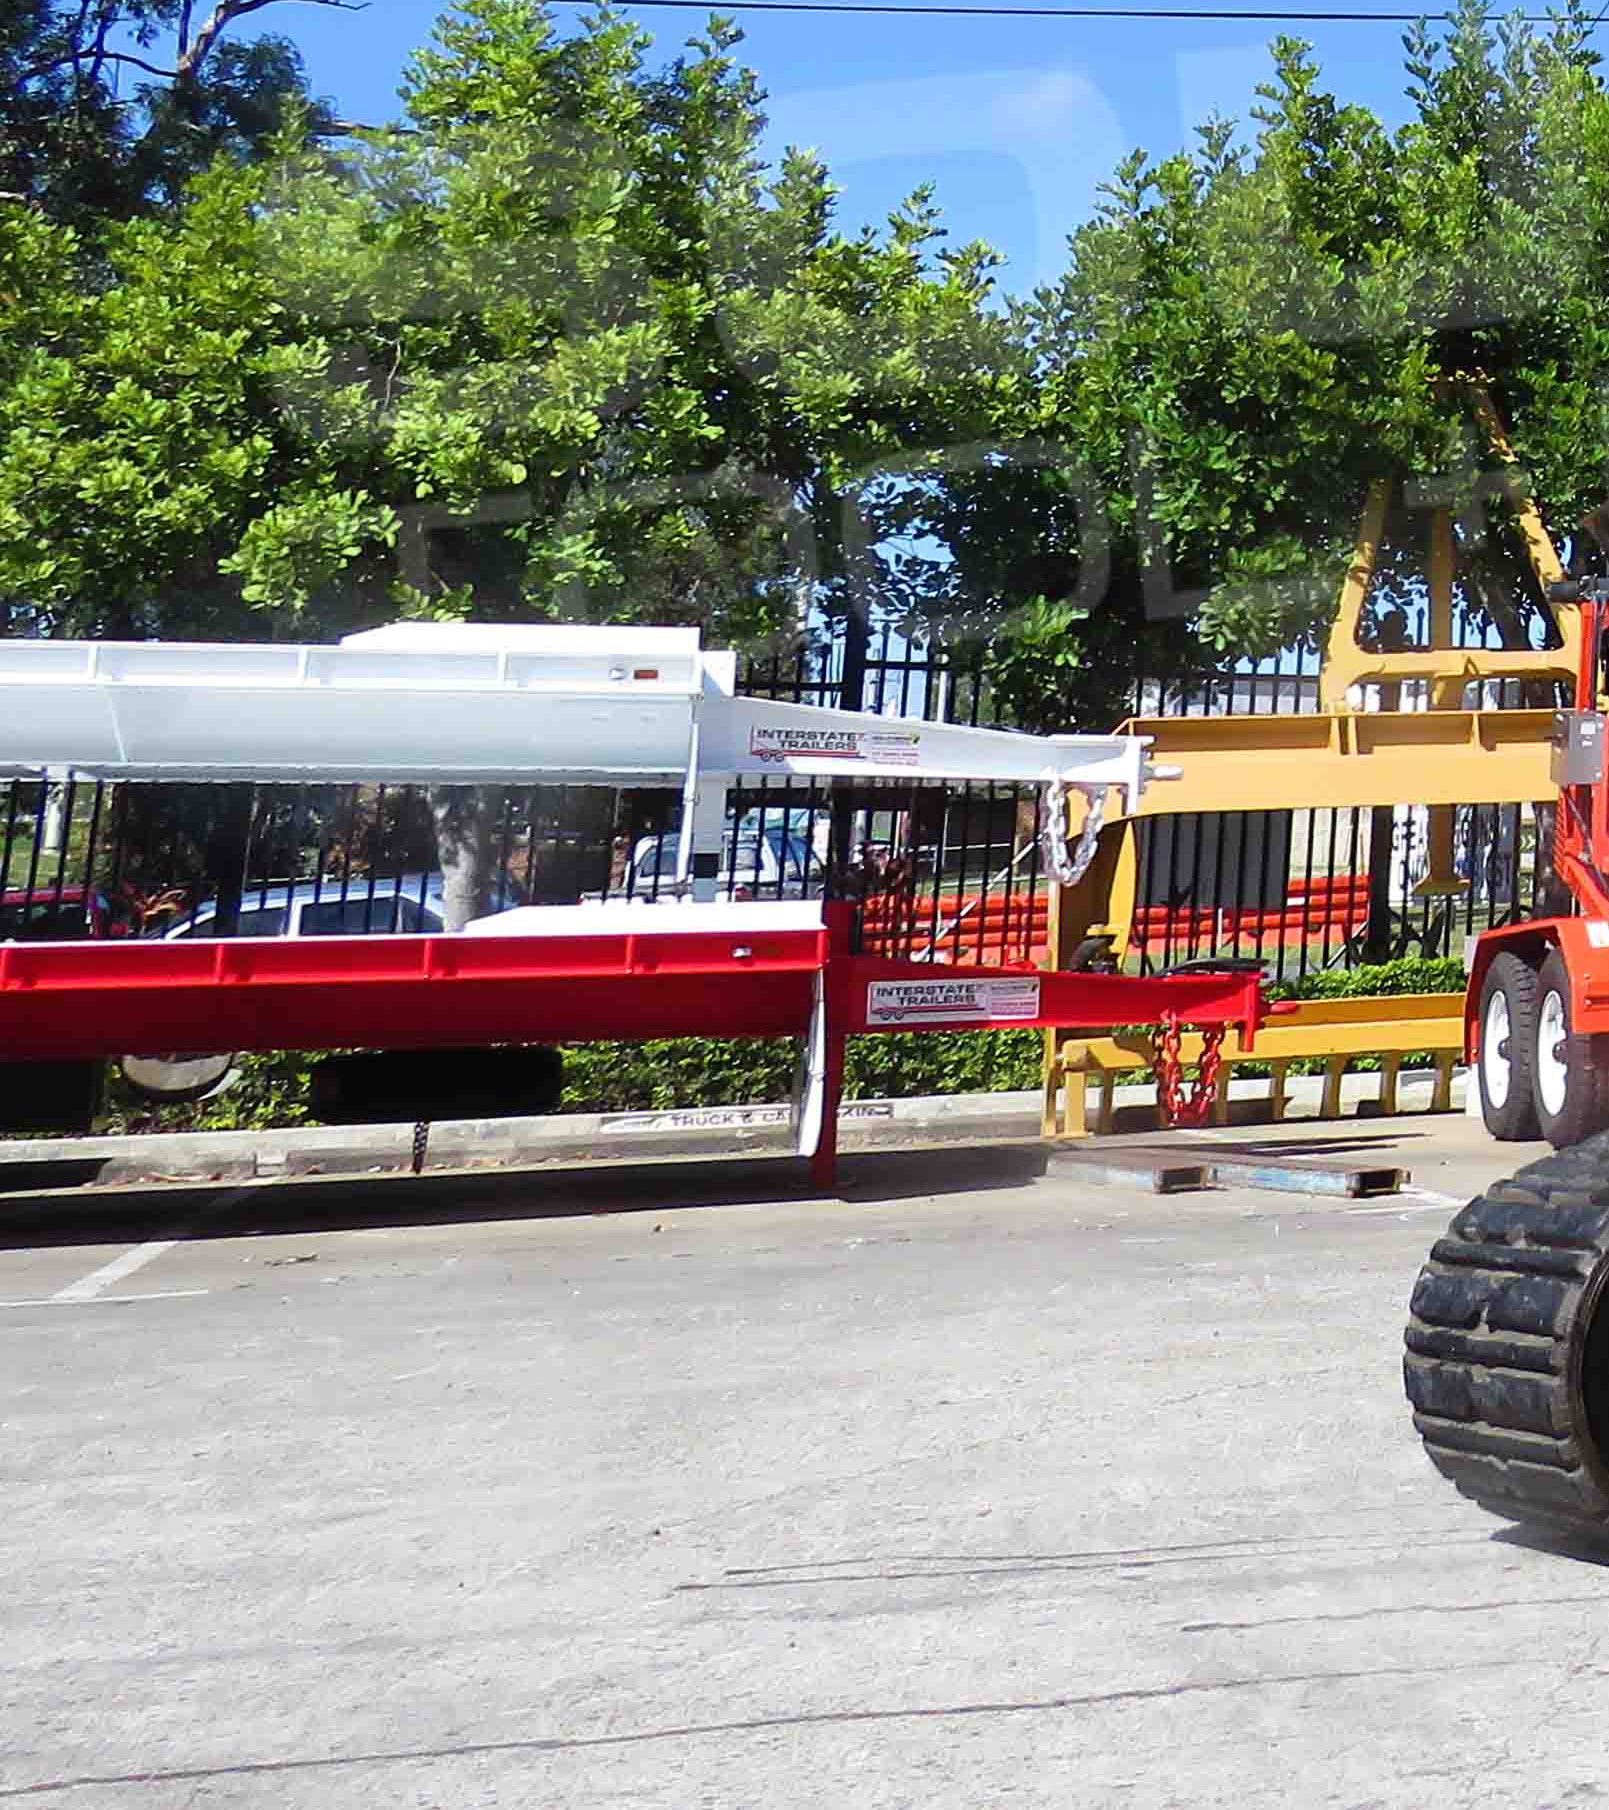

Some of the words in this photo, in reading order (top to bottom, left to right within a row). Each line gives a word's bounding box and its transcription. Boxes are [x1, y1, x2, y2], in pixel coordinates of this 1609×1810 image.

[756, 728, 857, 742] INTERSTATE
[779, 740, 858, 751] TRAILERS
[876, 983, 977, 997] INTERSTATE
[899, 994, 977, 1007] TRAILERS
